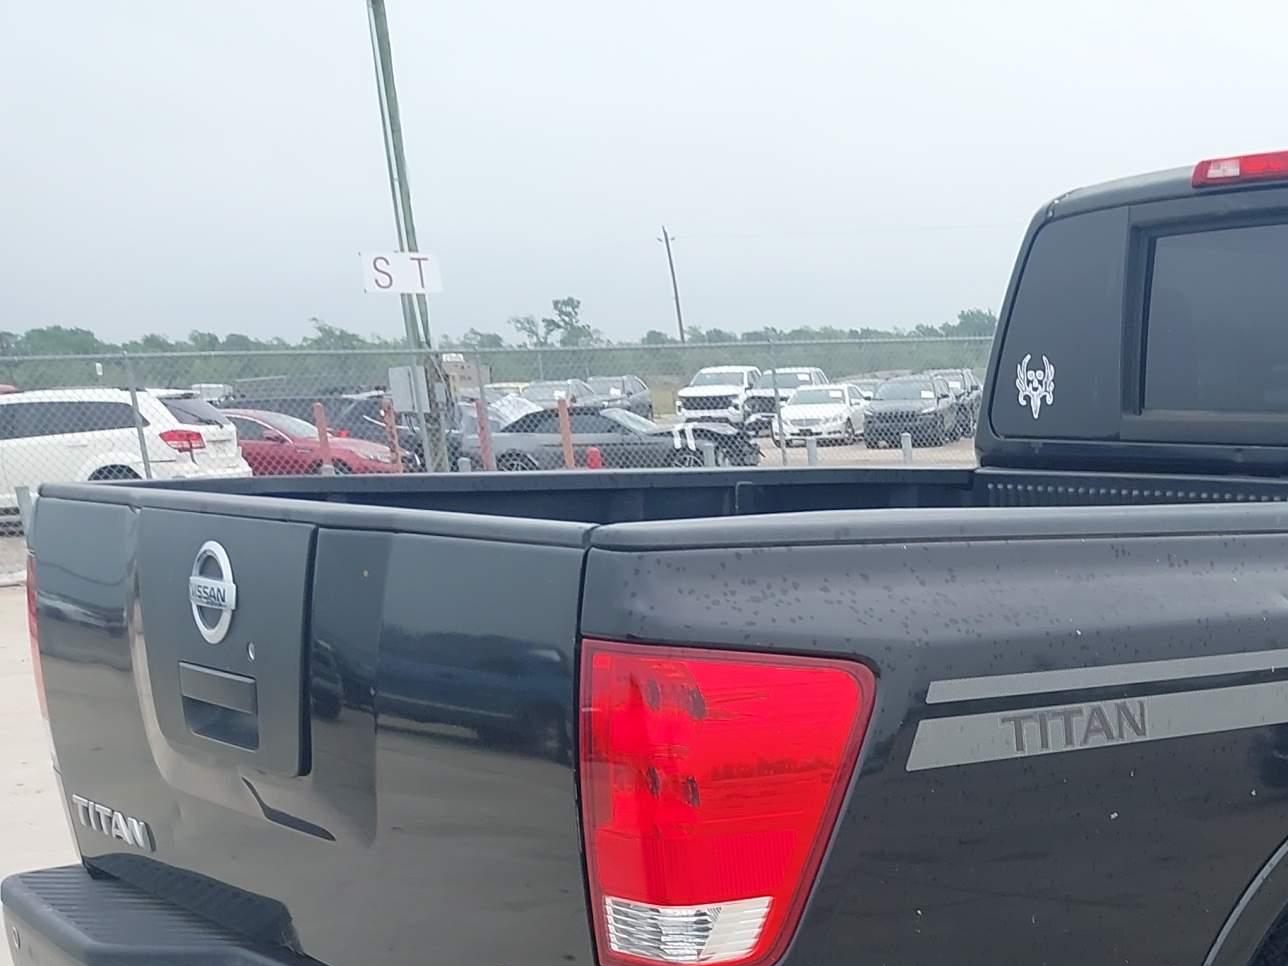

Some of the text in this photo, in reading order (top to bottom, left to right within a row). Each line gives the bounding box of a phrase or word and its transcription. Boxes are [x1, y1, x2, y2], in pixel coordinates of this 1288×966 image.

[372, 256, 429, 289] S T
[1001, 701, 1148, 752] TITAN
[72, 793, 155, 851] TITAN
